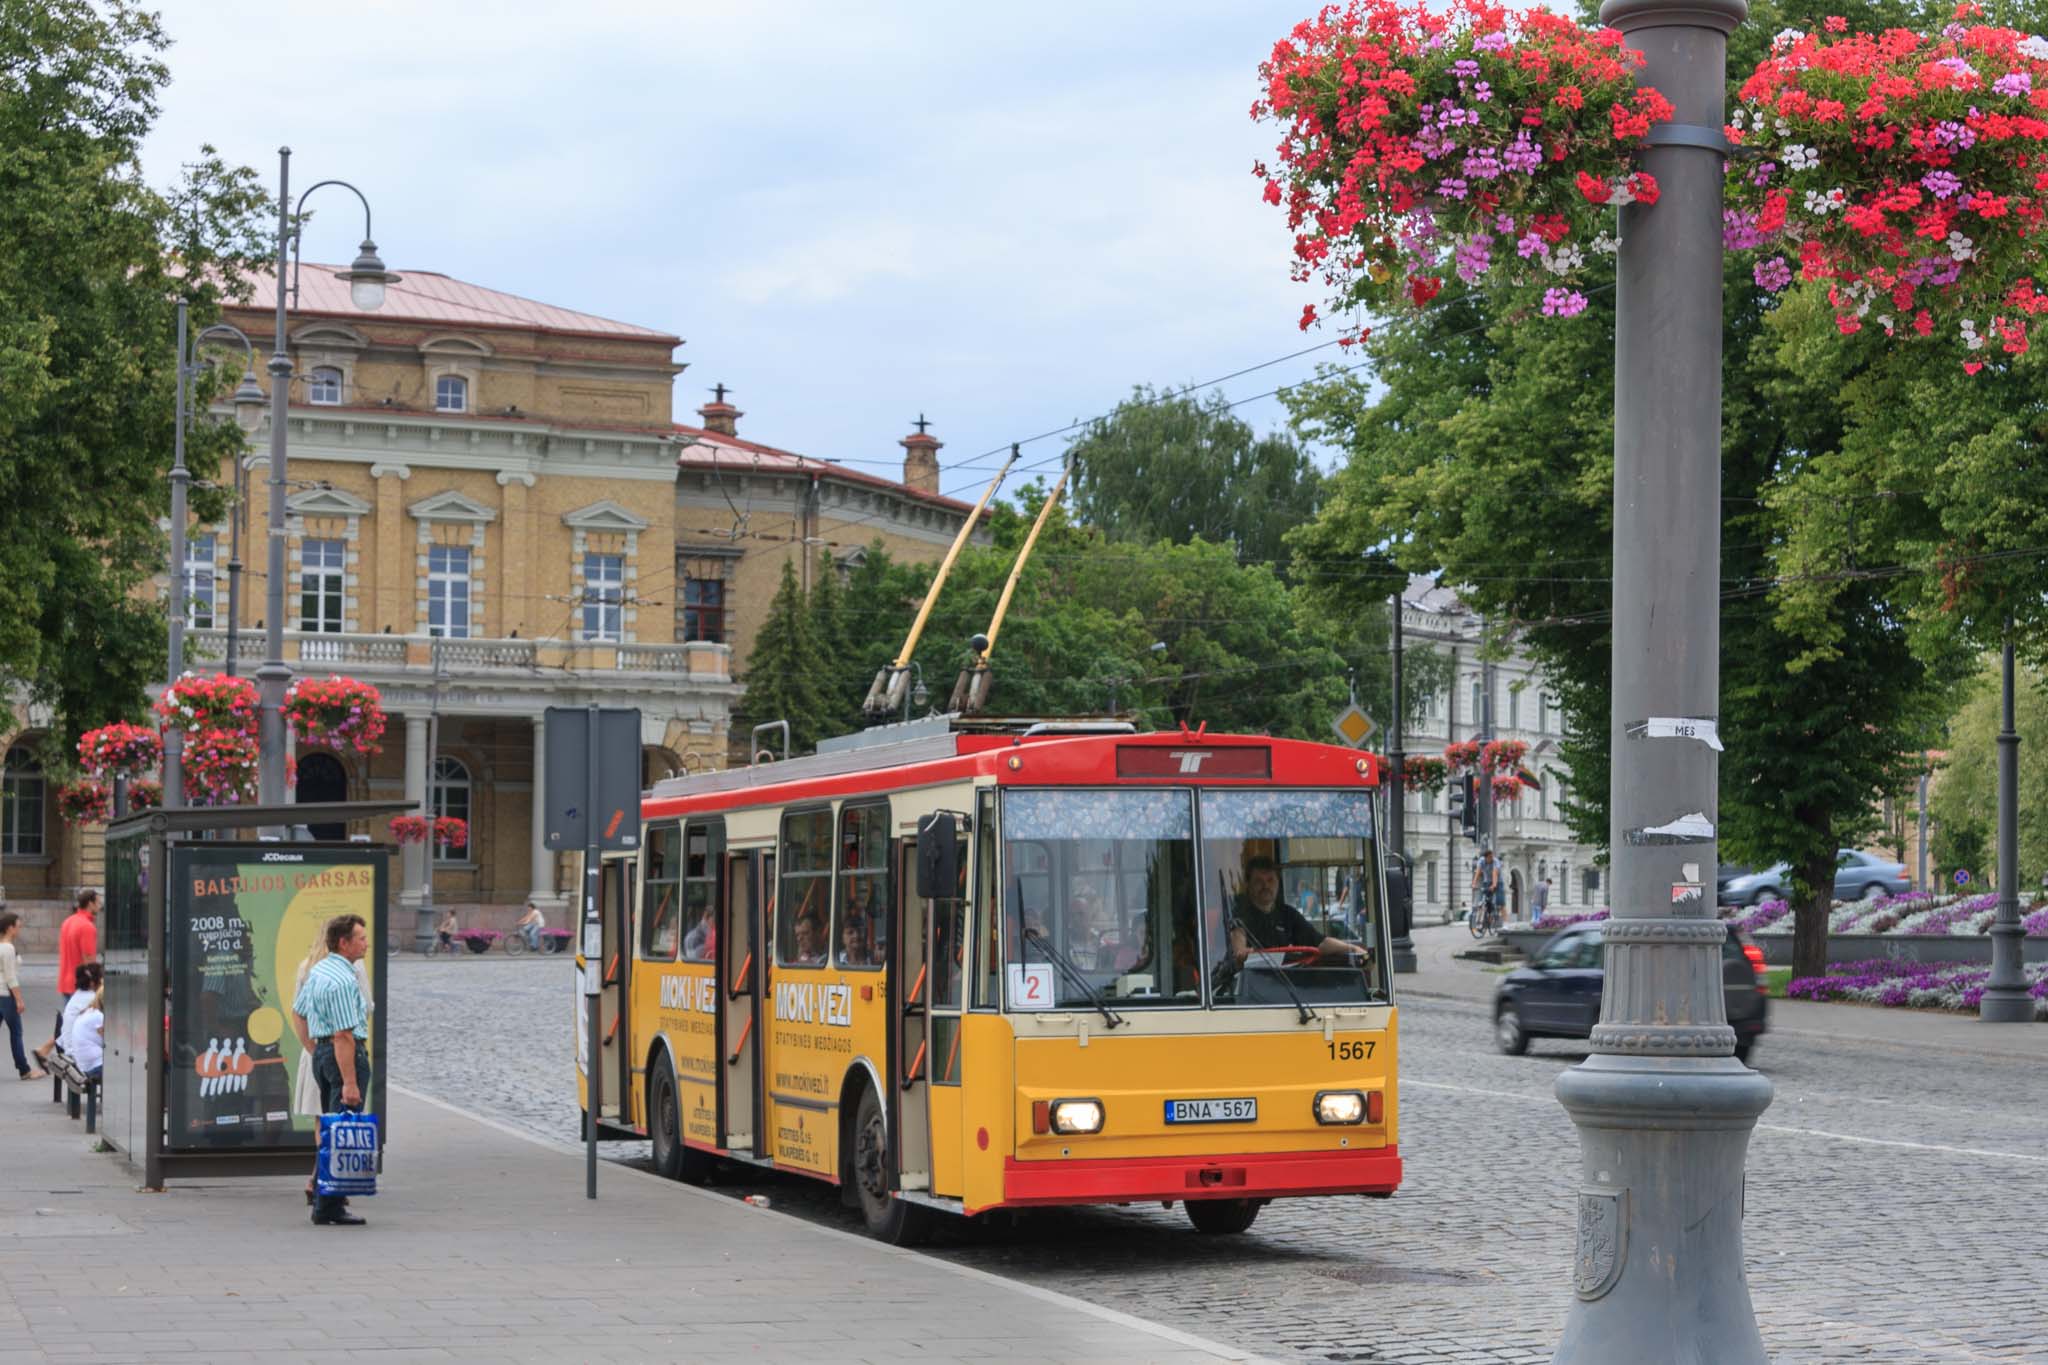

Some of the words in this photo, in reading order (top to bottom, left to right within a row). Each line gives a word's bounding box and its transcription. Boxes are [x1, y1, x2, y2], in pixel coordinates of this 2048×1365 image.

[262, 852, 304, 862] JCDecaux
[194, 875, 286, 897] BALTIJOS
[293, 870, 371, 890] GARSAS
[191, 916, 225, 932] 2008
[1026, 975, 1041, 1000] 2
[1327, 1041, 1376, 1061] 1567
[1176, 1102, 1212, 1119] BNA
[1223, 1101, 1254, 1117] 567
